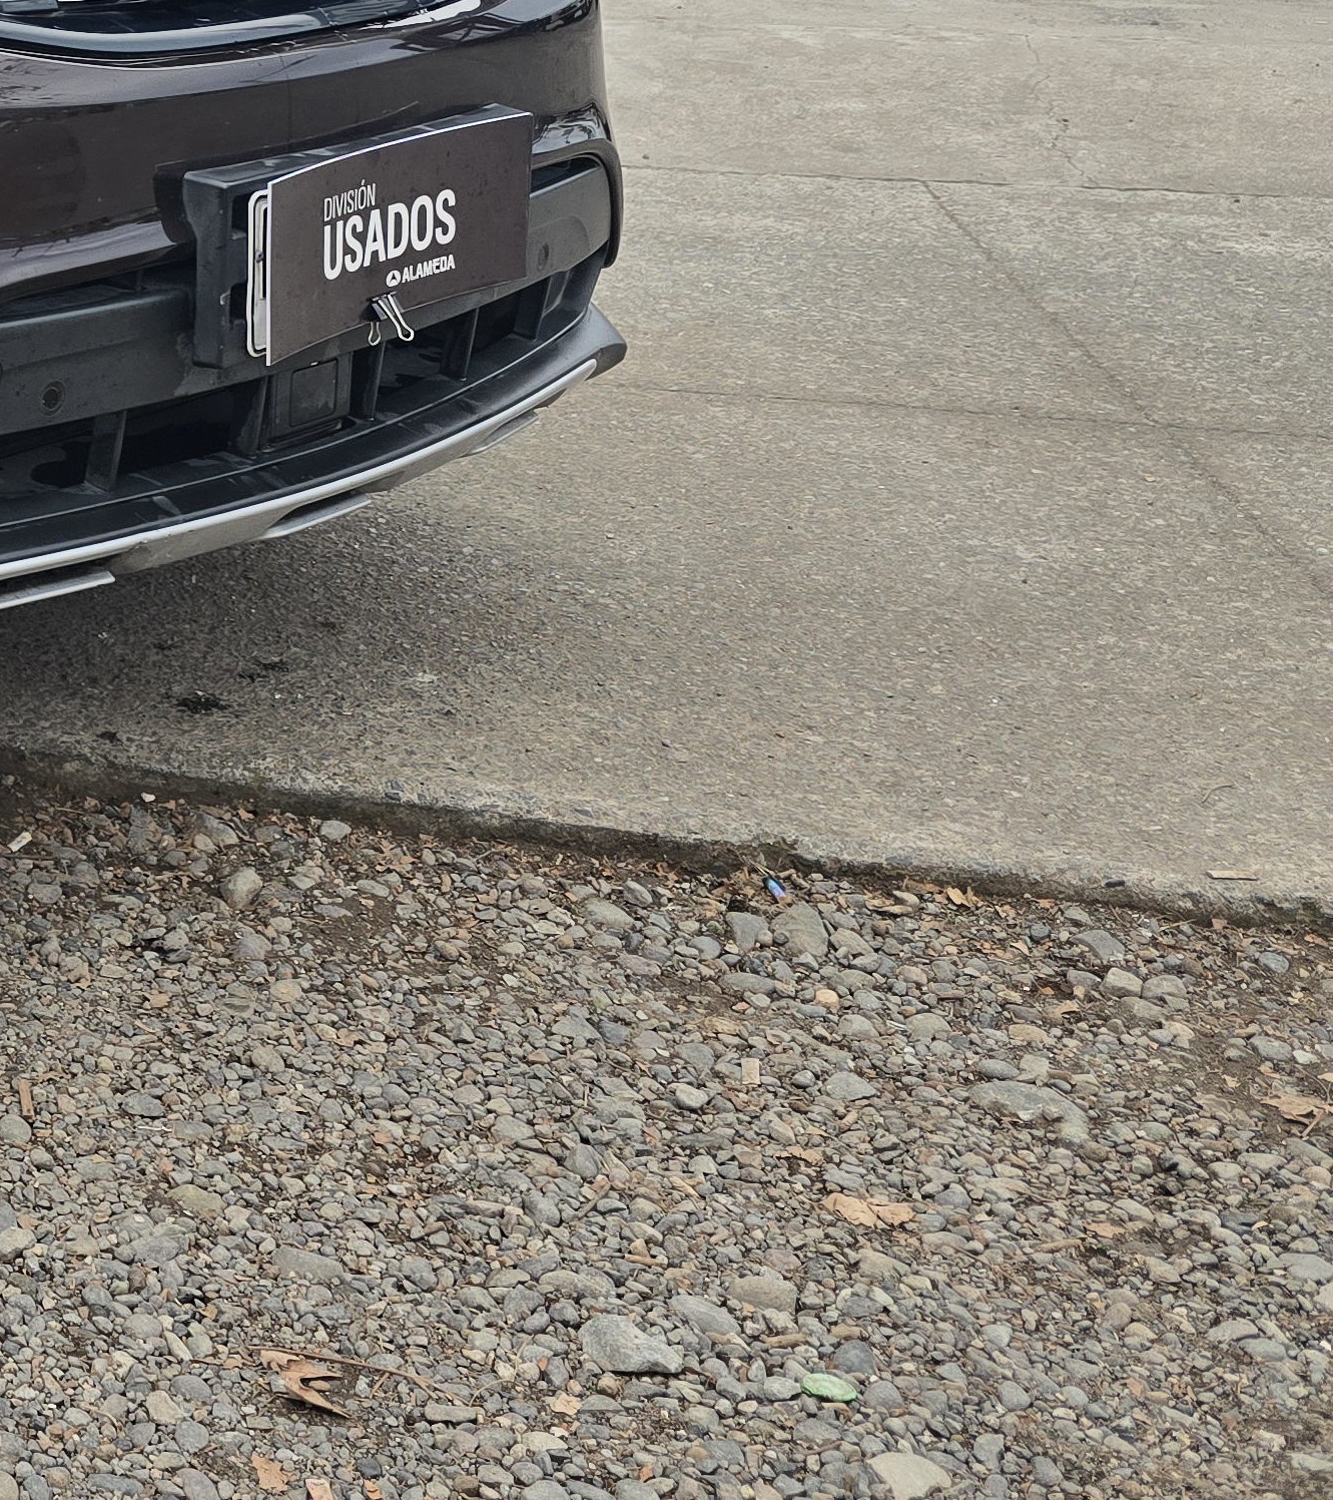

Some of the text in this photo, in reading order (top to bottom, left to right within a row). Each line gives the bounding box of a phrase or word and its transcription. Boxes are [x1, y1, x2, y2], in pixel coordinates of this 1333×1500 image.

[324, 179, 376, 222] DIVISIÓN
[323, 188, 457, 281] USADOS
[401, 254, 456, 283] ALAMEDA
